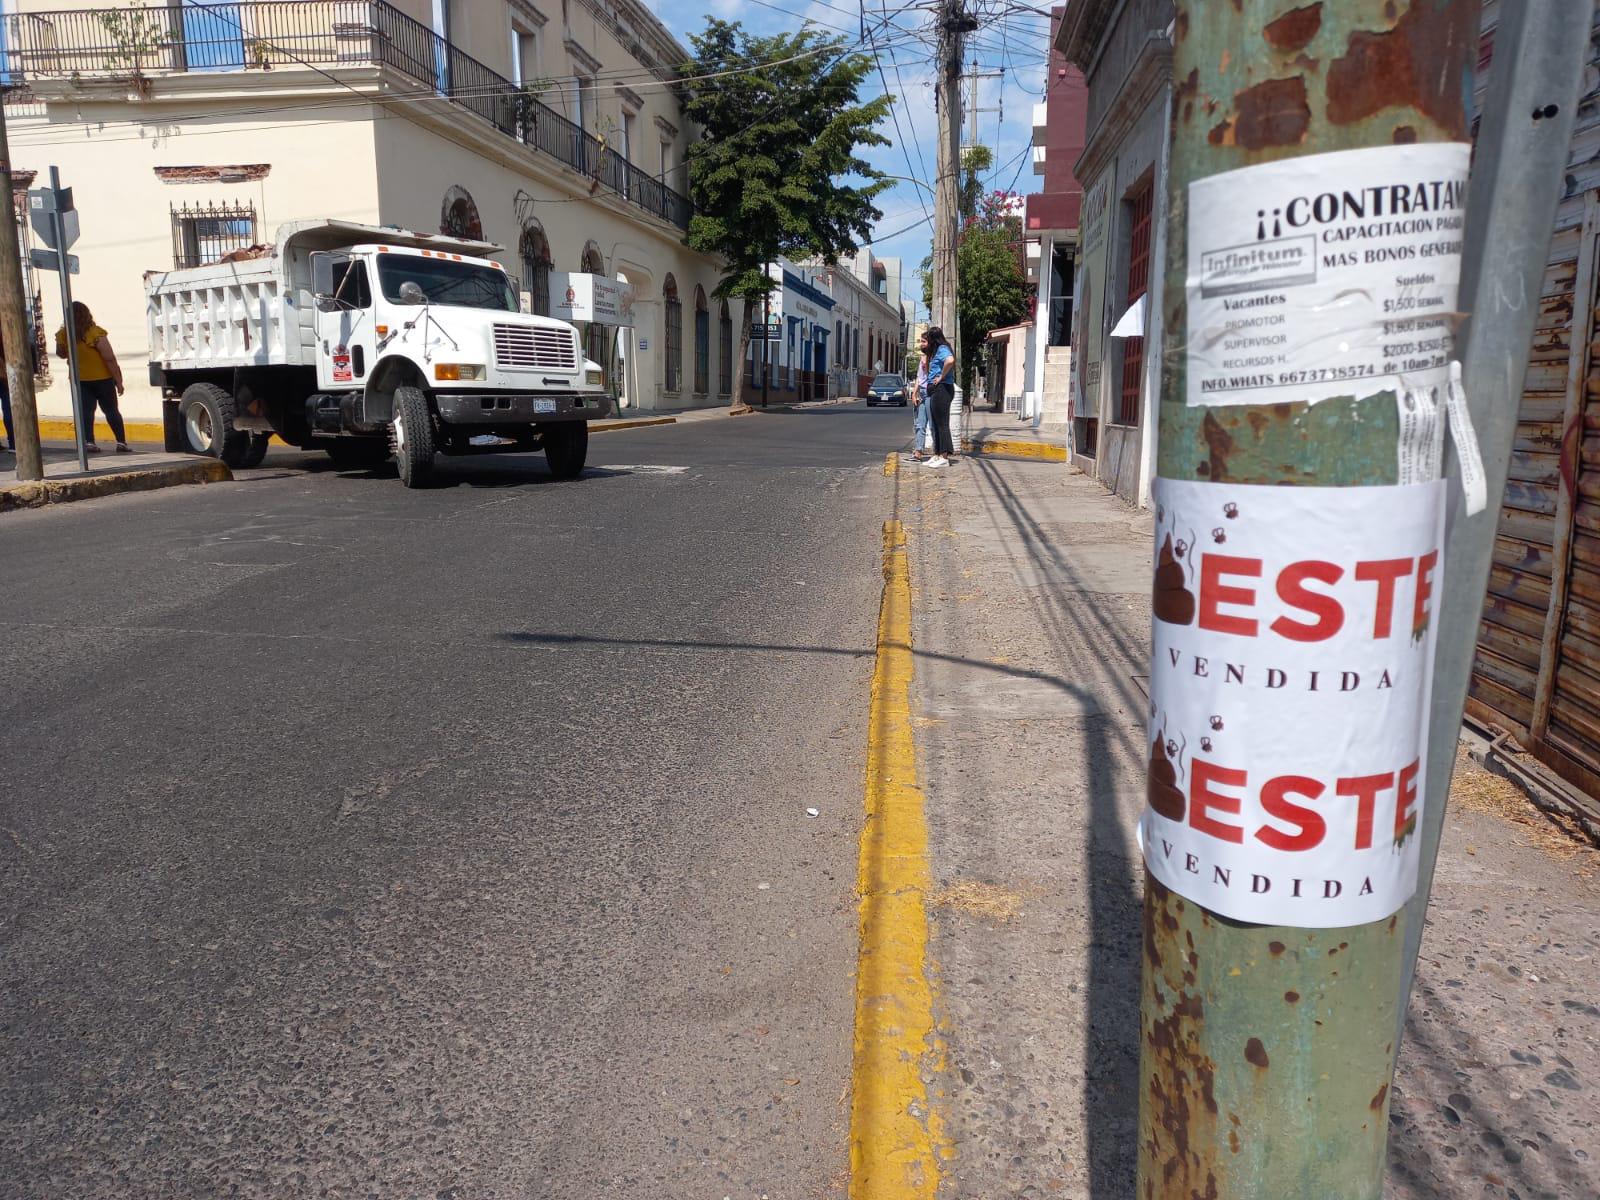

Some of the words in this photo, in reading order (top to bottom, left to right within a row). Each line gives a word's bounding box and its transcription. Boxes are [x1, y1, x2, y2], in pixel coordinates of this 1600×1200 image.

[1323, 218, 1433, 243] CAPACITACION
[1323, 251, 1358, 268] MAS
[1365, 245, 1416, 263] BONOS
[1395, 273, 1435, 287] Sueldos
[1224, 294, 1286, 310] Vacantes
[1225, 314, 1285, 329] PROMOTOR
[1224, 334, 1287, 350] SUPERVISOR
[1222, 355, 1275, 369] RECURSOS
[1201, 373, 1274, 391] INFO.WHATS
[1383, 362, 1398, 374] de
[1199, 549, 1439, 643] ESTE
[1169, 647, 1393, 692] VENDIDA
[1189, 757, 1420, 852] ESTE
[1161, 839, 1374, 898] VENDIDA
